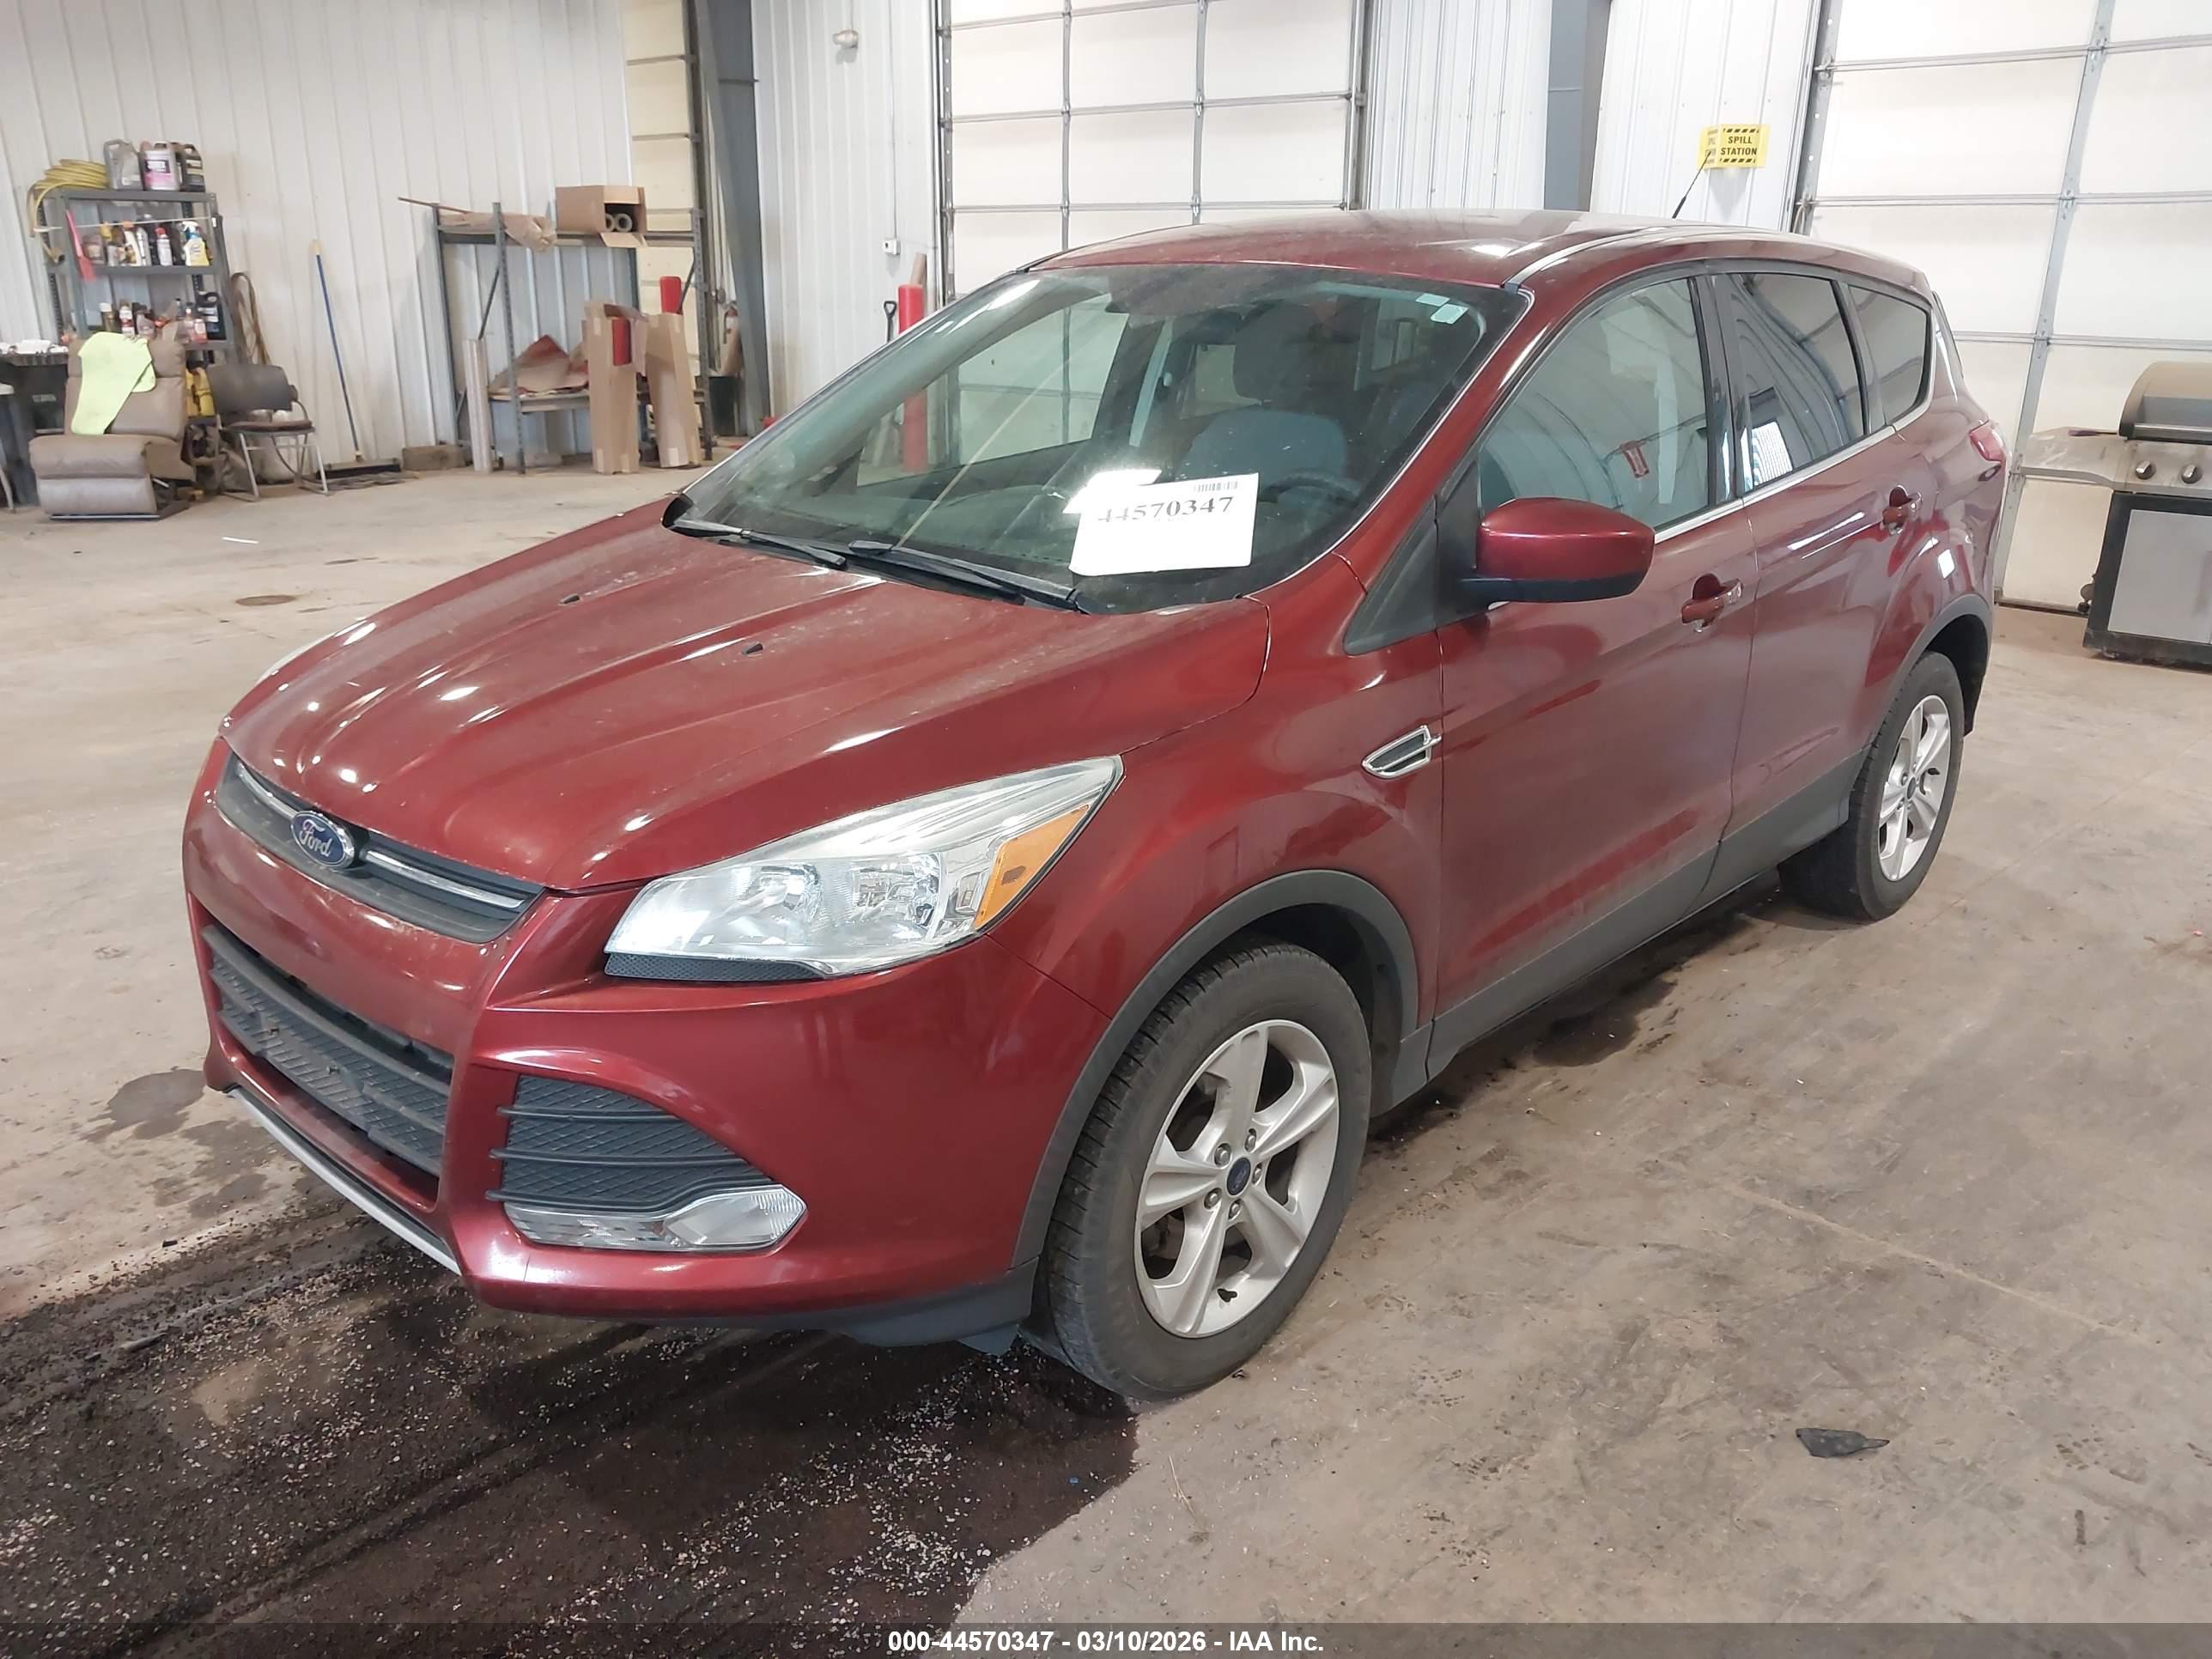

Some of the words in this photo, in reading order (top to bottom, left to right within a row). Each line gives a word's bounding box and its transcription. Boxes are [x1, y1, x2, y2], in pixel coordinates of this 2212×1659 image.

[1728, 136, 1753, 144] SPILL
[1720, 147, 1758, 155] STATION
[298, 818, 333, 858] Ford
